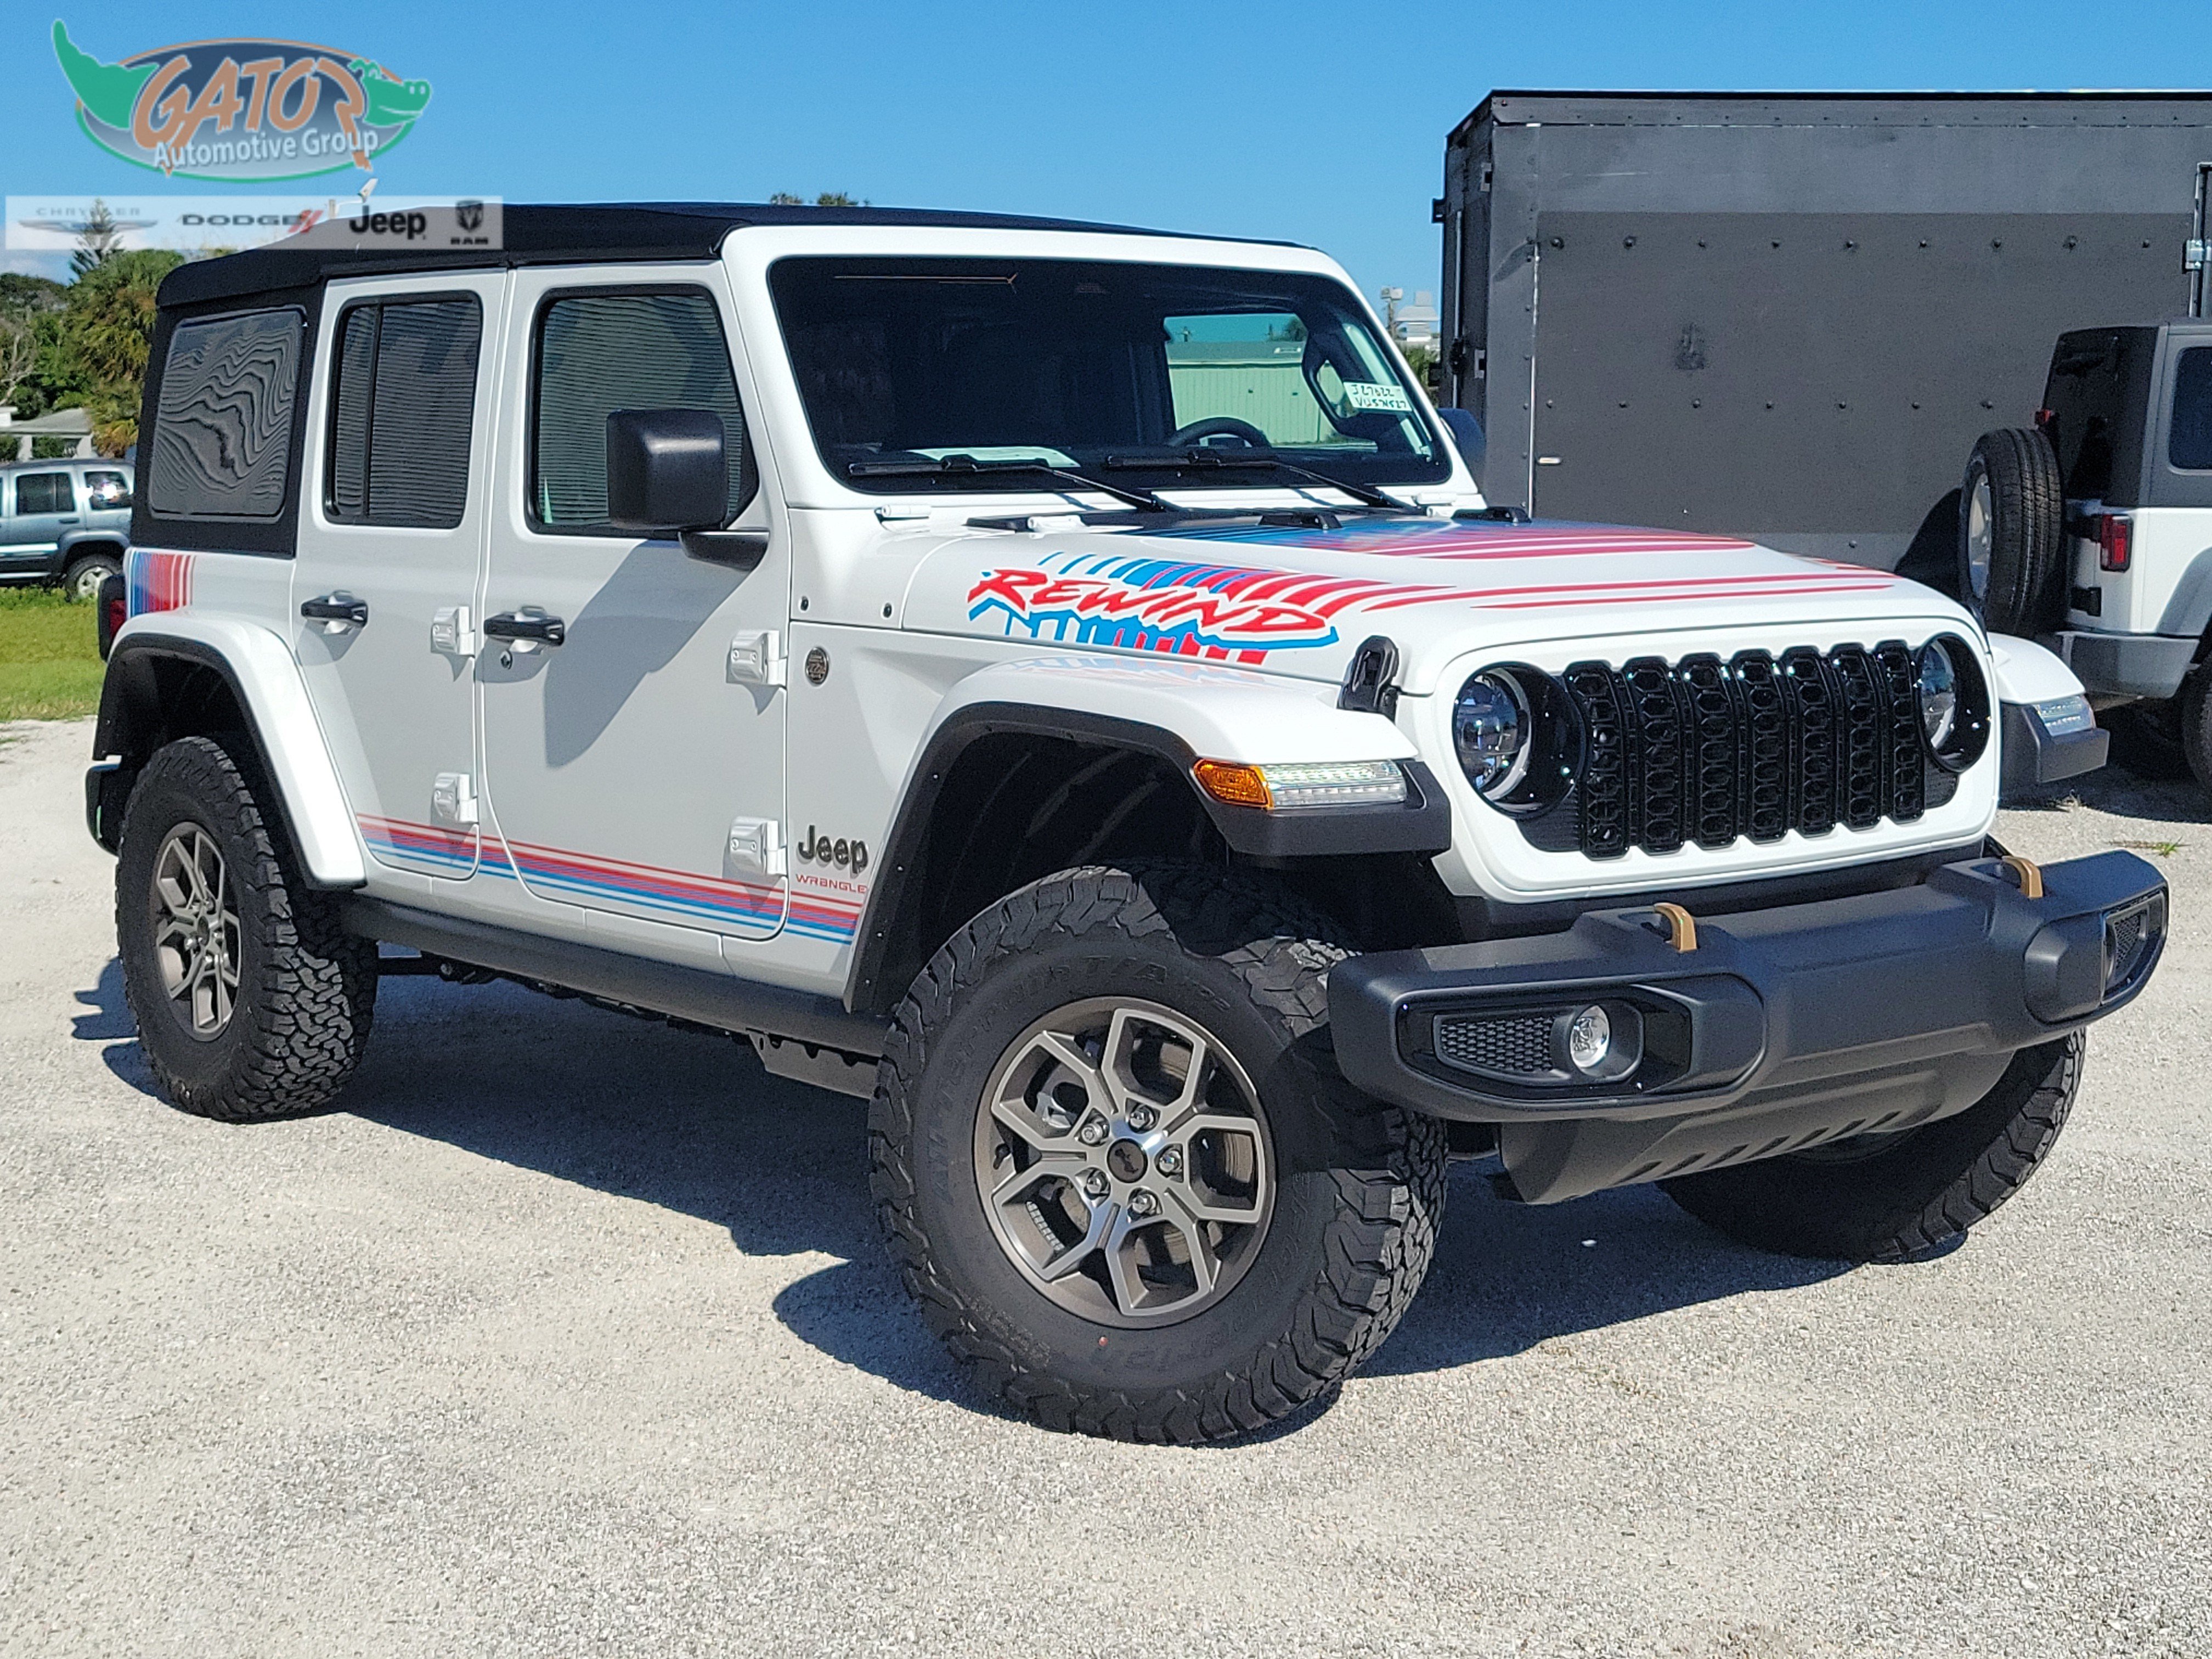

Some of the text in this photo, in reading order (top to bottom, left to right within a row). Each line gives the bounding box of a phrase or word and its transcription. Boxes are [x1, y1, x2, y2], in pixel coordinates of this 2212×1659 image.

[968, 569, 1326, 632] REWIND
[797, 825, 868, 874] Jeep
[796, 873, 868, 894] WRANGLE
